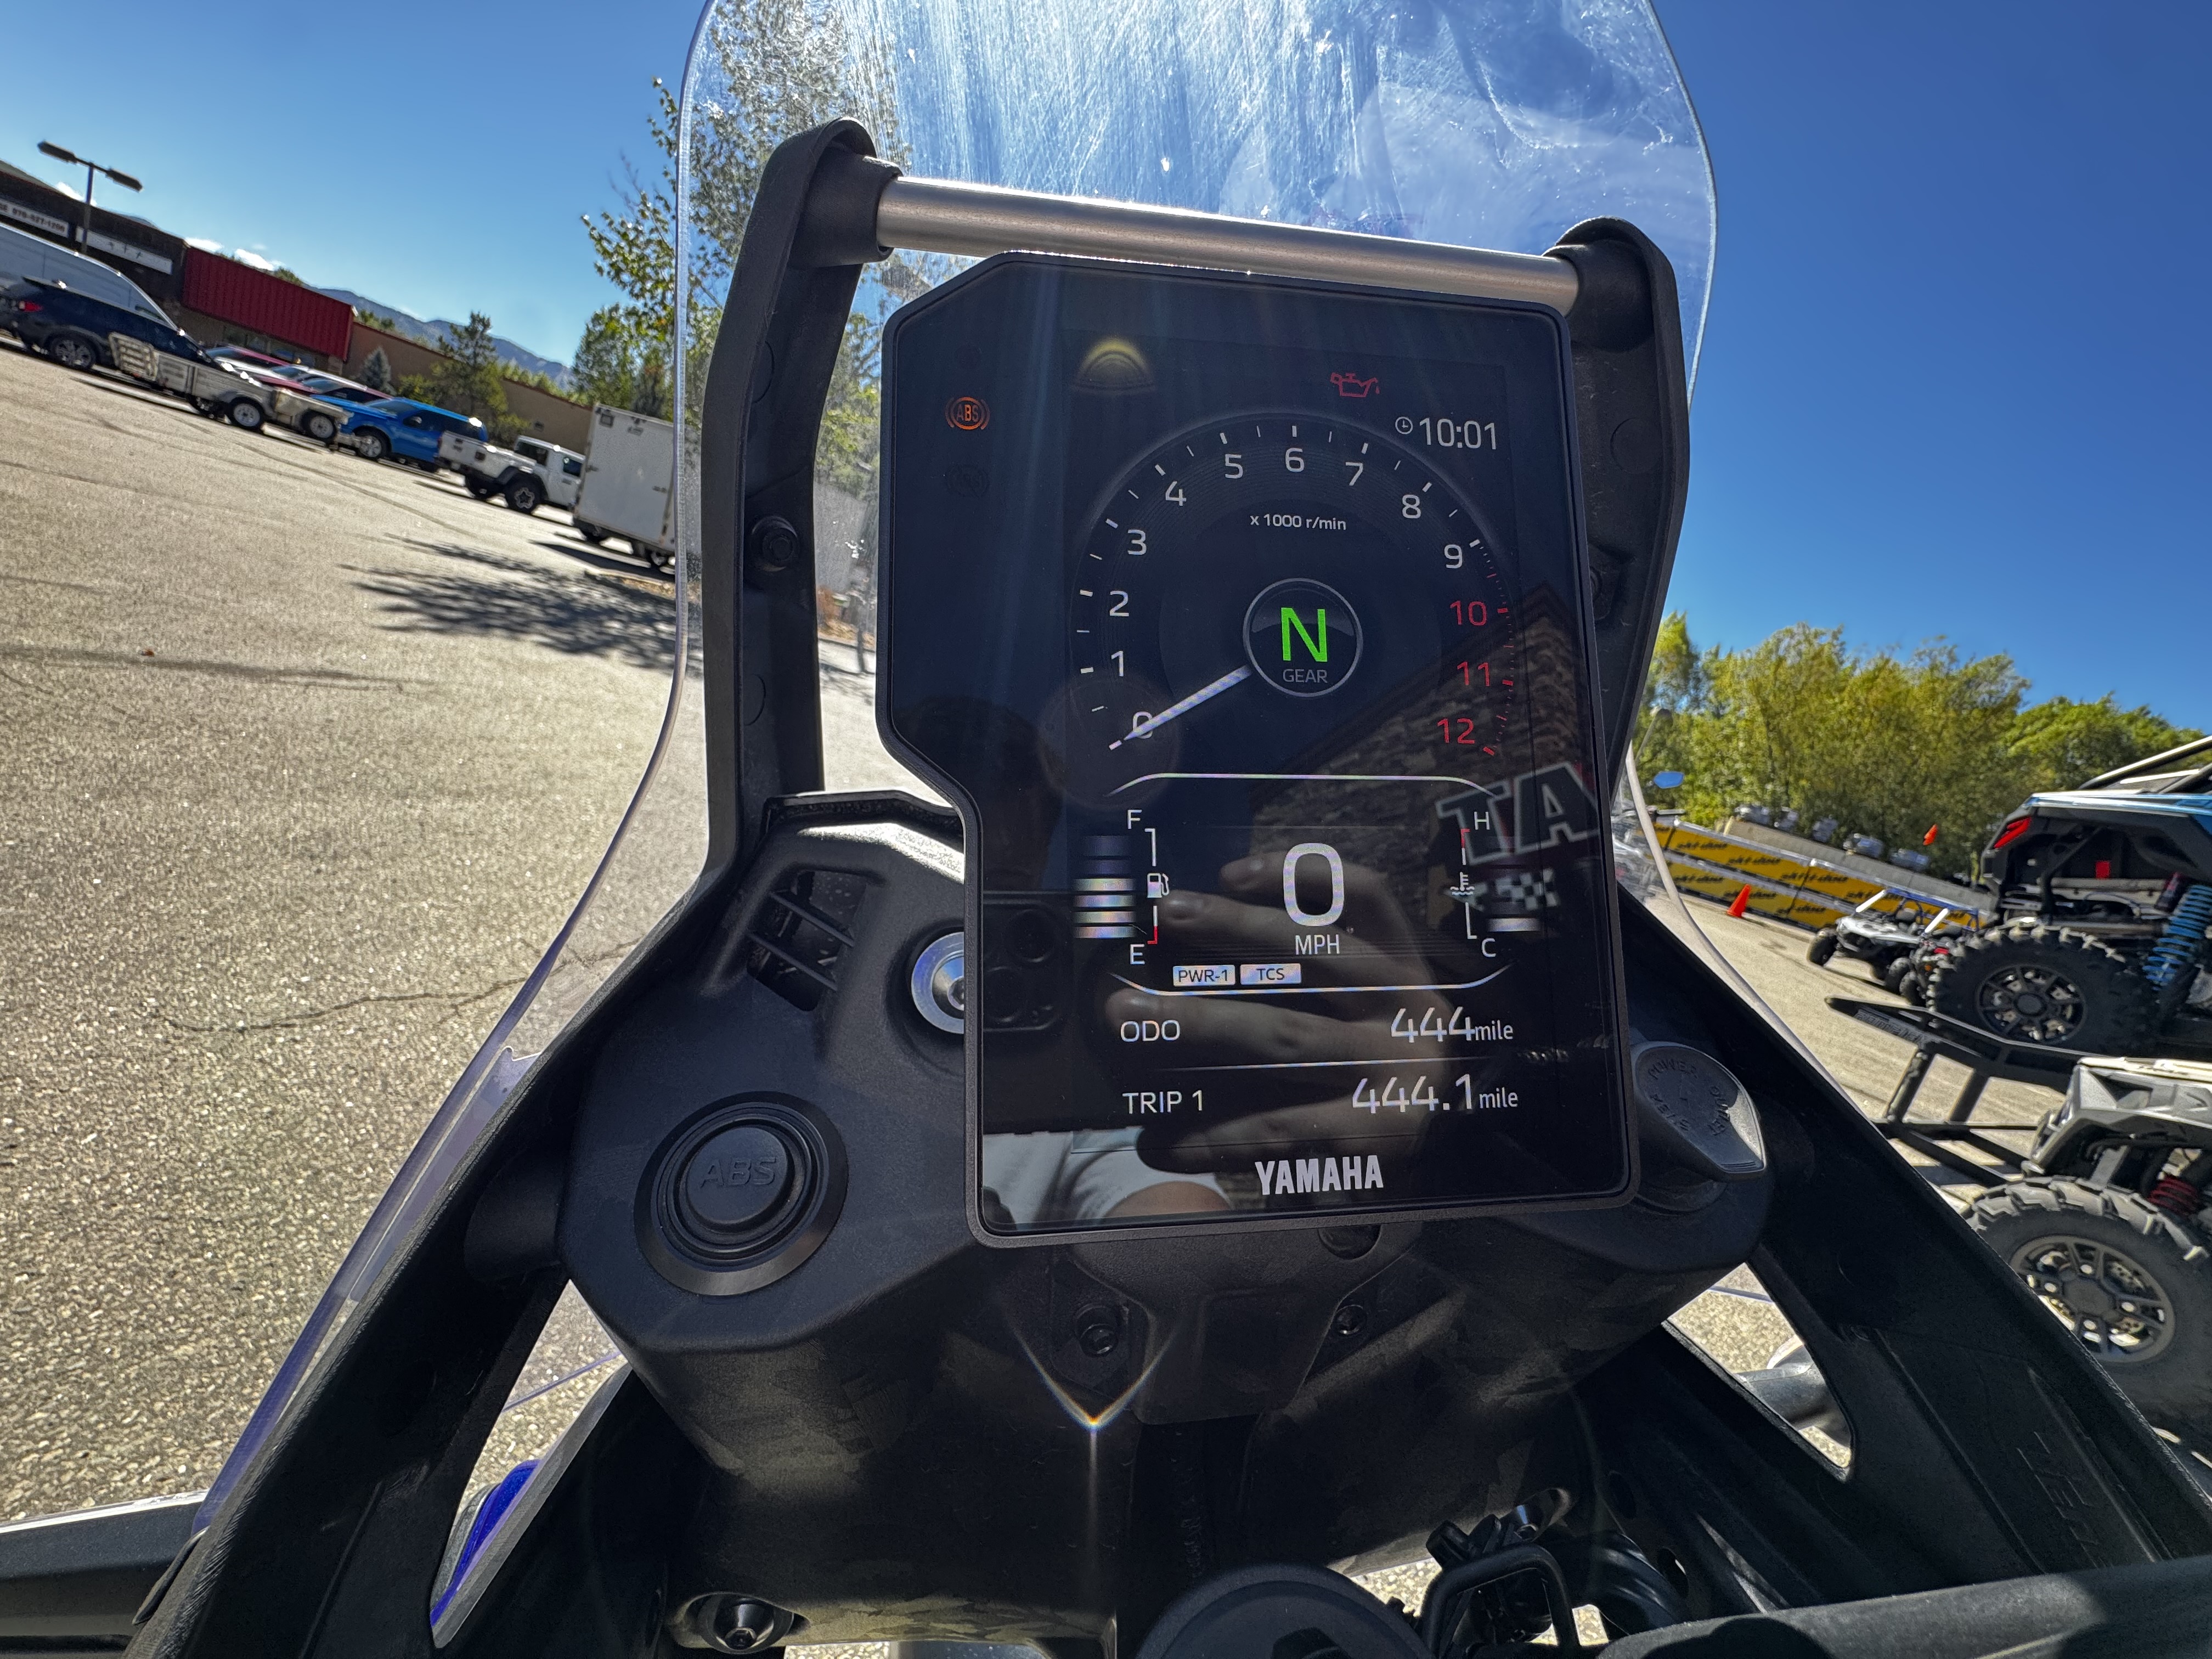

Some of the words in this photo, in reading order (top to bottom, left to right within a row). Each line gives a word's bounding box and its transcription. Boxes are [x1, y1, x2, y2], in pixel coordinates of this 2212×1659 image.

[1420, 418, 1496, 449] 10:01
[1225, 454, 1243, 478] 5
[1285, 448, 1304, 472] 6
[1346, 462, 1363, 486] 7
[1166, 481, 1186, 506] 4
[1402, 495, 1421, 518] 8
[1250, 516, 1259, 525] x
[1264, 514, 1301, 527] 1000
[1306, 517, 1346, 530] r/min
[1127, 529, 1146, 555] 3
[1444, 545, 1463, 568] 9
[1110, 591, 1129, 616] 2
[1451, 601, 1487, 625] 10
[1282, 608, 1327, 662] N
[1111, 651, 1124, 676] 1
[1457, 662, 1489, 686] 11
[1283, 669, 1328, 683] GEAR
[1132, 712, 1153, 739] 0
[1438, 718, 1475, 744] 12
[1128, 810, 1142, 829] F
[1474, 812, 1489, 830] H
[1283, 843, 1344, 926] 0
[1130, 944, 1144, 964] E
[1295, 934, 1340, 955] MPH
[1482, 938, 1496, 957] C
[1178, 969, 1227, 982] PWR-1
[1256, 968, 1285, 980] TCS
[1121, 1020, 1180, 1041] ODO
[1122, 1091, 1182, 1114] TRIP
[1193, 1090, 1202, 1110] 1
[700, 1156, 777, 1188] ABS
[1255, 1155, 1384, 1195] YAMAHA
